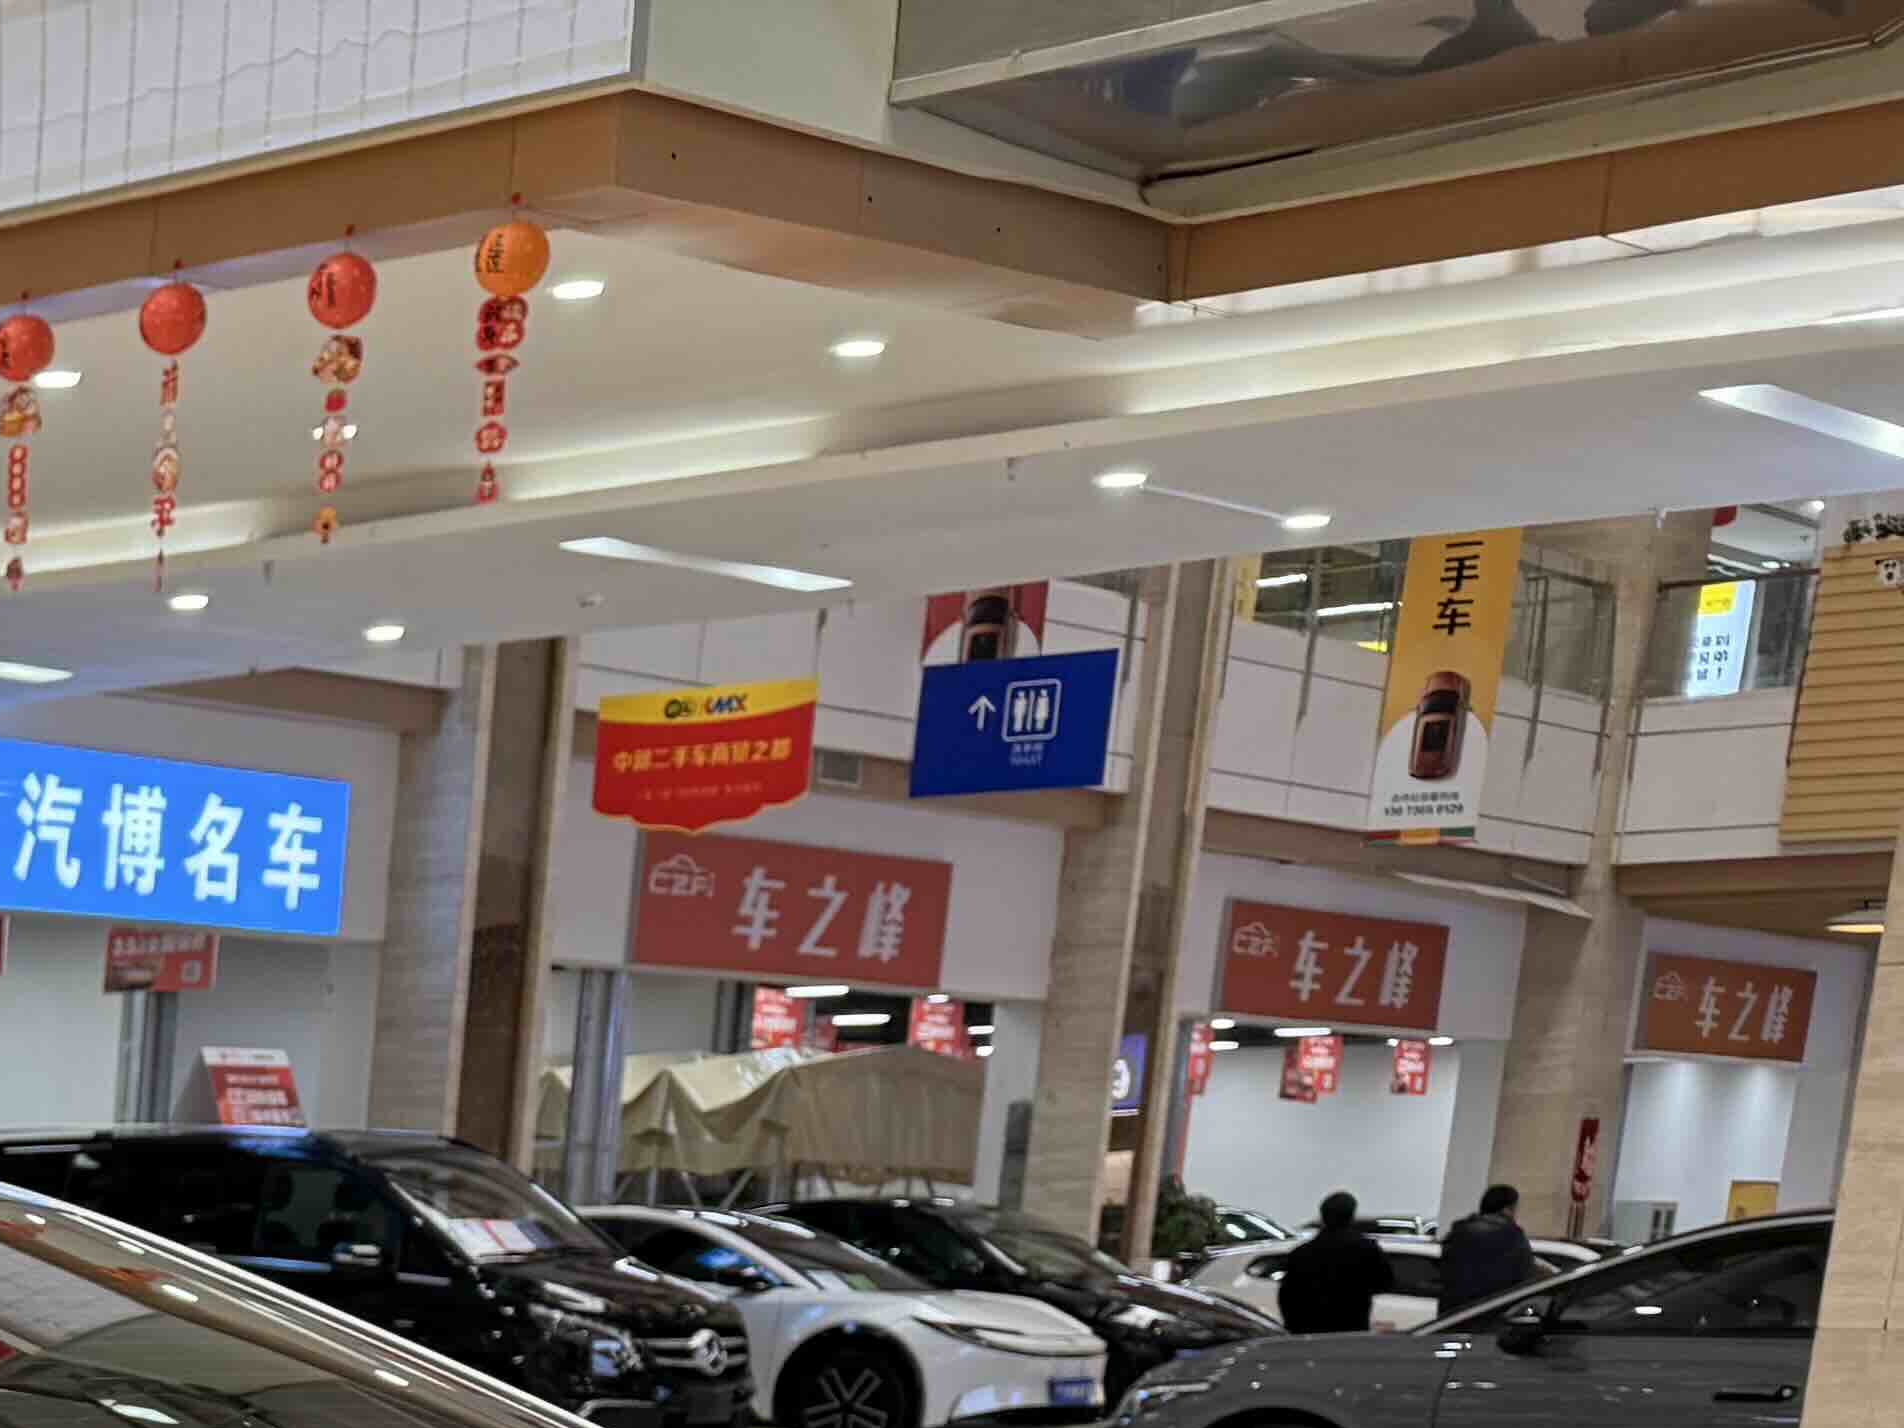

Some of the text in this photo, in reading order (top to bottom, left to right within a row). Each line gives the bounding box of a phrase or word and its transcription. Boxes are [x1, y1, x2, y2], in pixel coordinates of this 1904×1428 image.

[12, 770, 324, 912] 汽博名车
[731, 865, 913, 964] 车之峰
[1288, 929, 1420, 1009] 车之峰
[1694, 975, 1794, 1043] 车之峰
